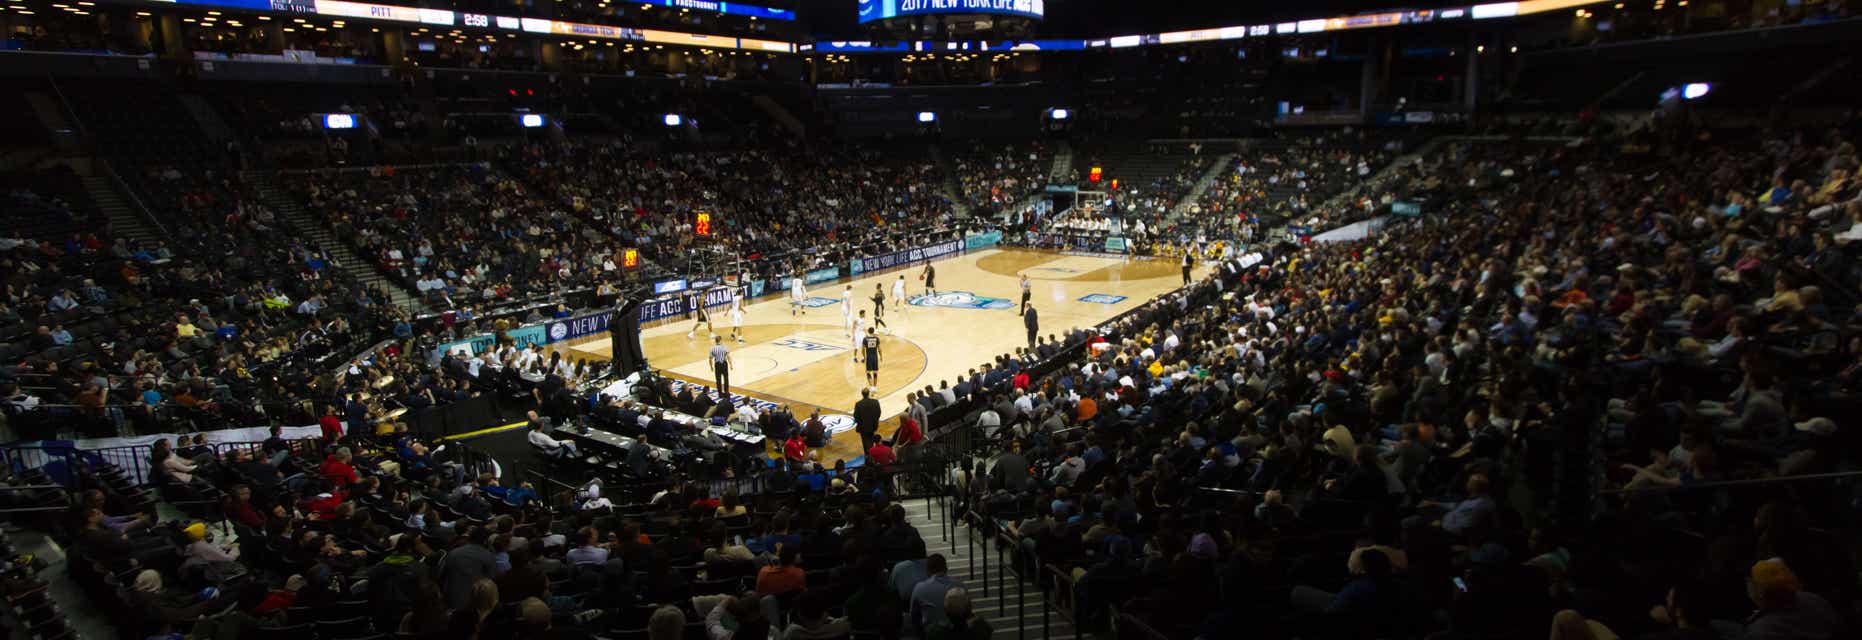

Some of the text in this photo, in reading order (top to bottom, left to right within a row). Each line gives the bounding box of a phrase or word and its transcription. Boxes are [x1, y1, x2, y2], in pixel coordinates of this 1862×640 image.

[371, 7, 391, 16] PITT
[909, 247, 922, 260] ACC
[572, 316, 599, 335] NEW
[660, 299, 681, 316] ACC
